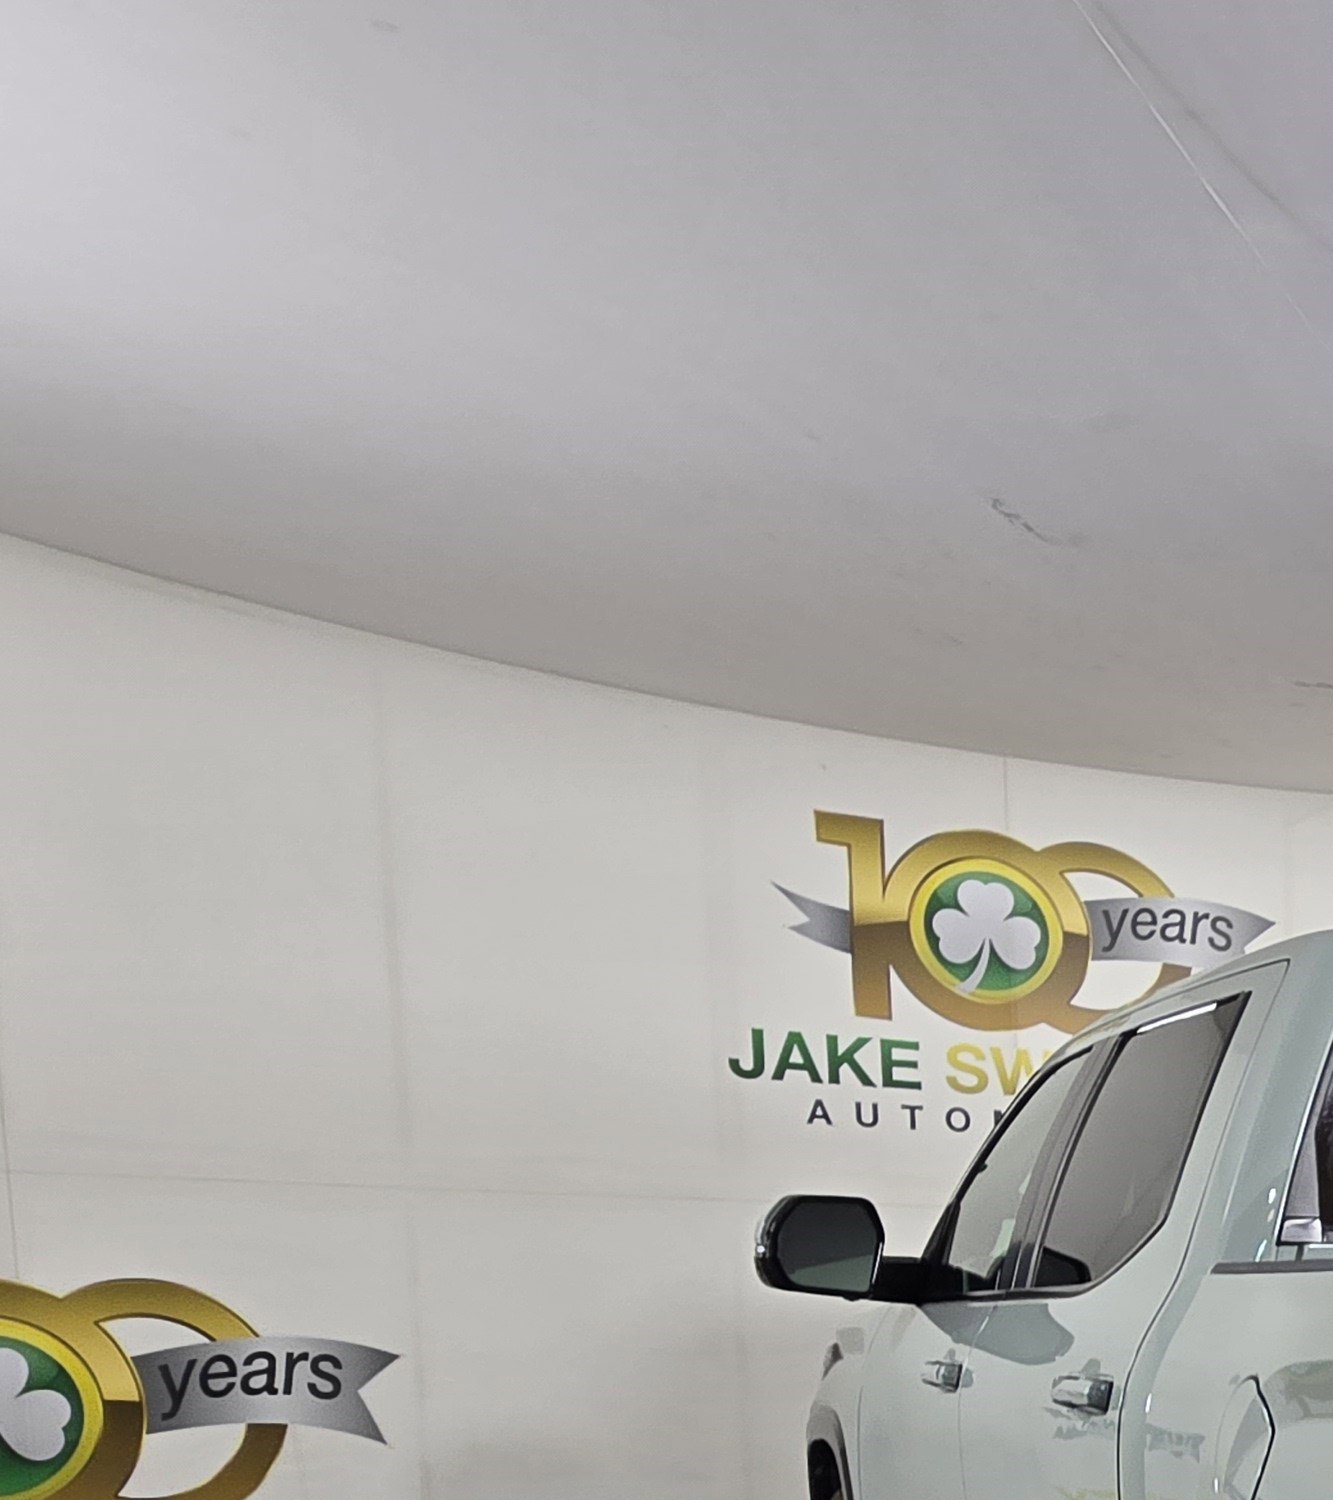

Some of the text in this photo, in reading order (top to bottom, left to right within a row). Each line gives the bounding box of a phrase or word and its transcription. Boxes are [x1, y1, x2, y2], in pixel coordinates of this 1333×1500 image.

[814, 809, 1234, 1036] 100 years
[728, 1027, 1050, 1096] JAKE SW
[158, 1349, 343, 1422] years
